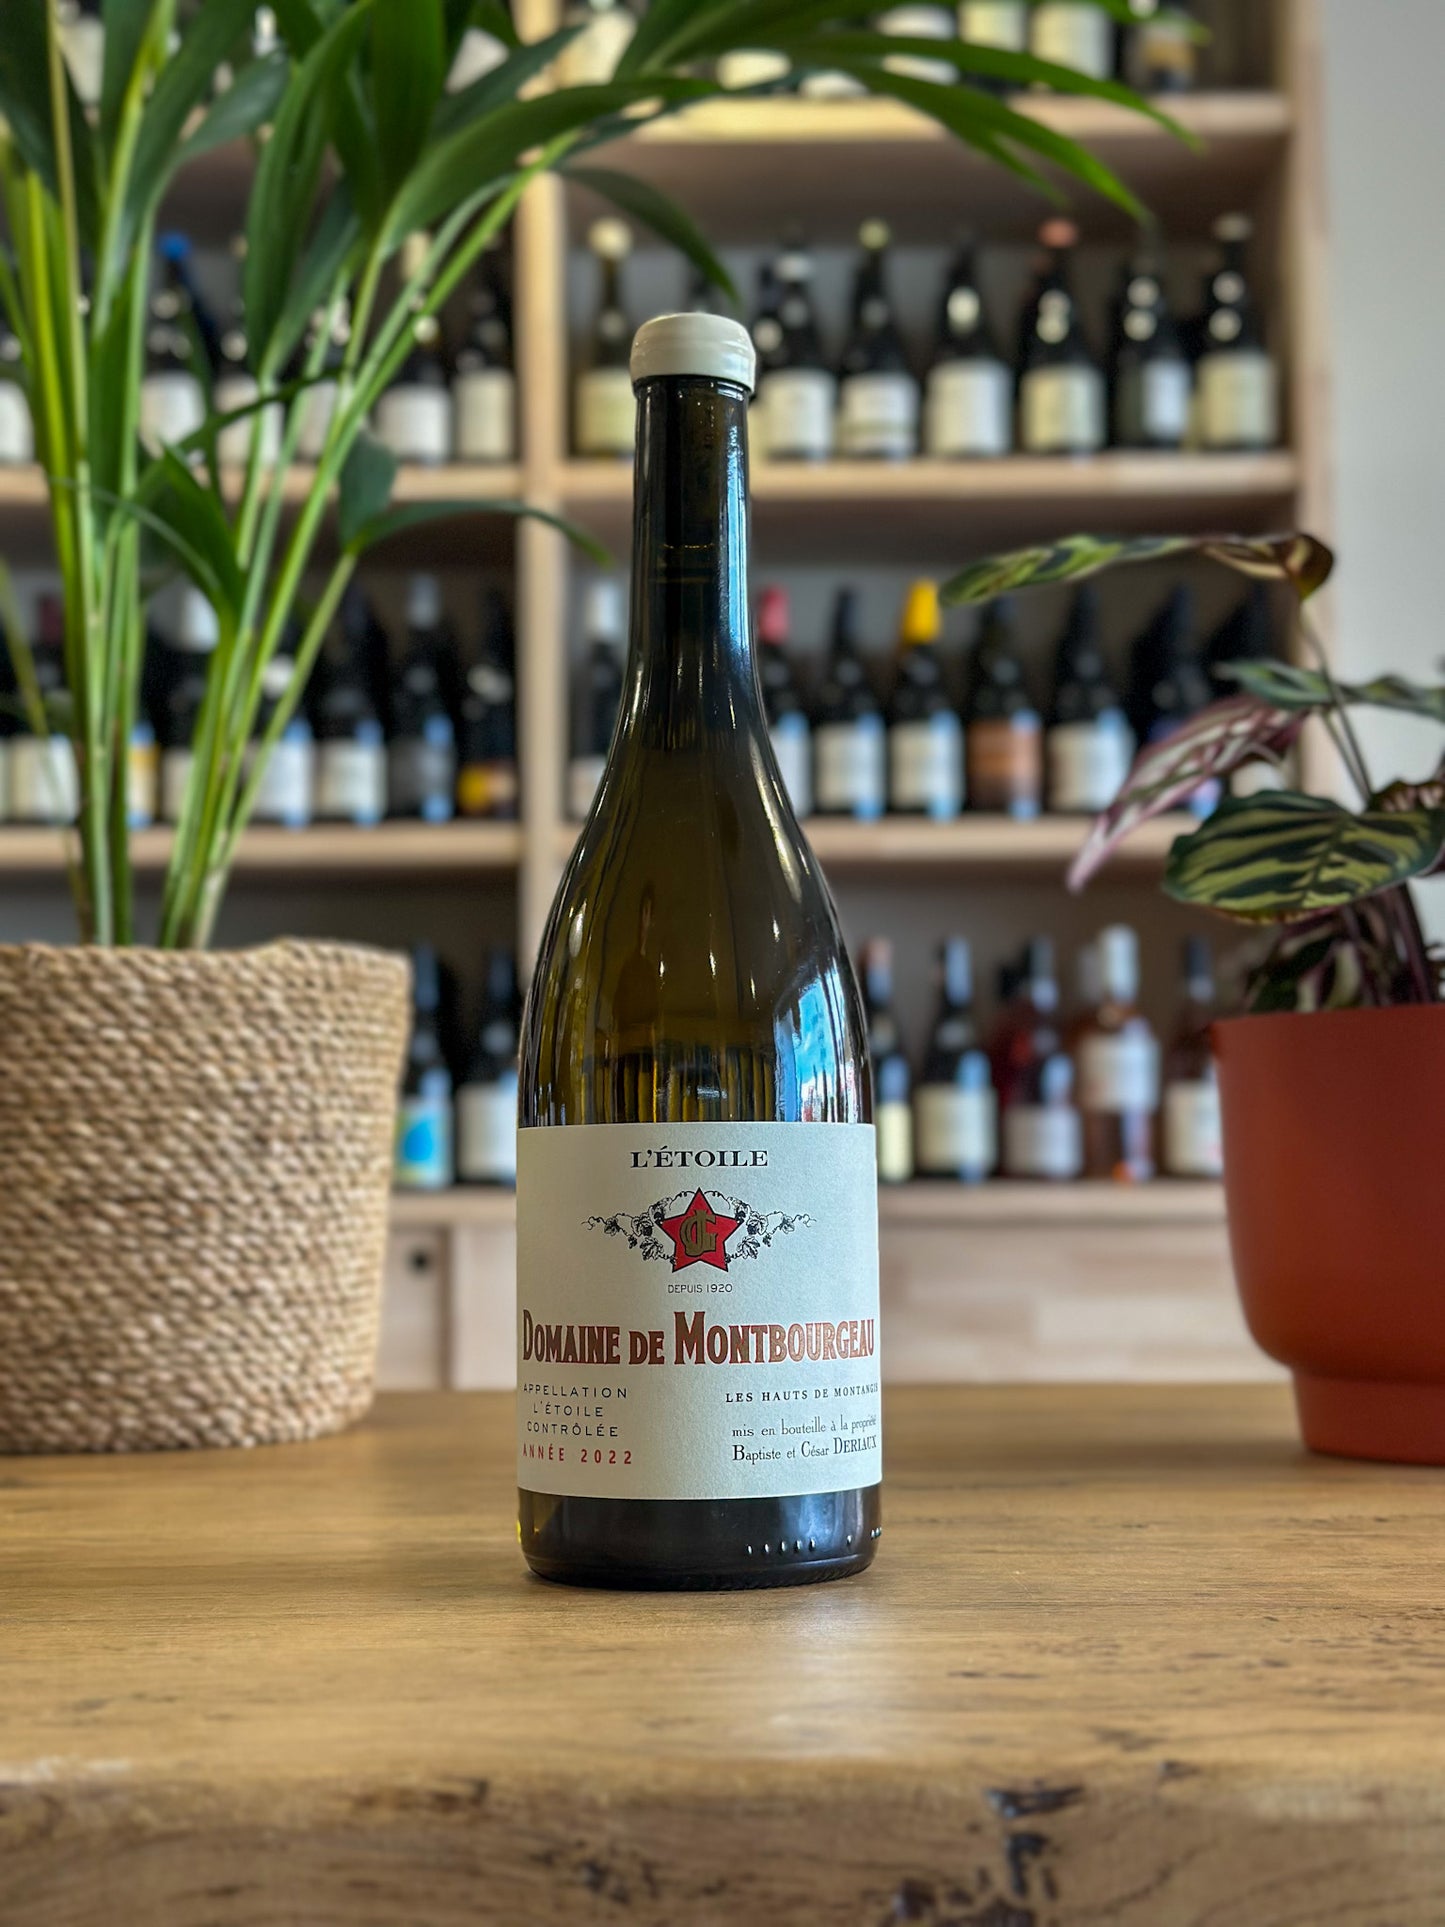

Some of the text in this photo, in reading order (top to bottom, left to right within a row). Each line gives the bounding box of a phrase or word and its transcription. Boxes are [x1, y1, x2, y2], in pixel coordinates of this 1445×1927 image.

[667, 1283, 733, 1294] DEPUIS 1920
[523, 1309, 875, 1365] DOMAINE DE MONTBOURGEAU
[523, 1384, 627, 1399] APPELLATION
[725, 1392, 753, 1403] LES
[762, 1389, 808, 1402] HAUTS
[814, 1388, 829, 1399] DE
[533, 1401, 603, 1417] L'ÉTOILE
[527, 1421, 618, 1437] CONTRÔLÉE
[732, 1424, 755, 1437] mis
[761, 1427, 775, 1436] en
[781, 1416, 826, 1435] bouteille
[830, 1421, 836, 1431] à
[840, 1414, 848, 1430] la
[522, 1443, 632, 1464] ANNÉE 2022
[732, 1435, 877, 1465] Baptiste et César DERIAUX
